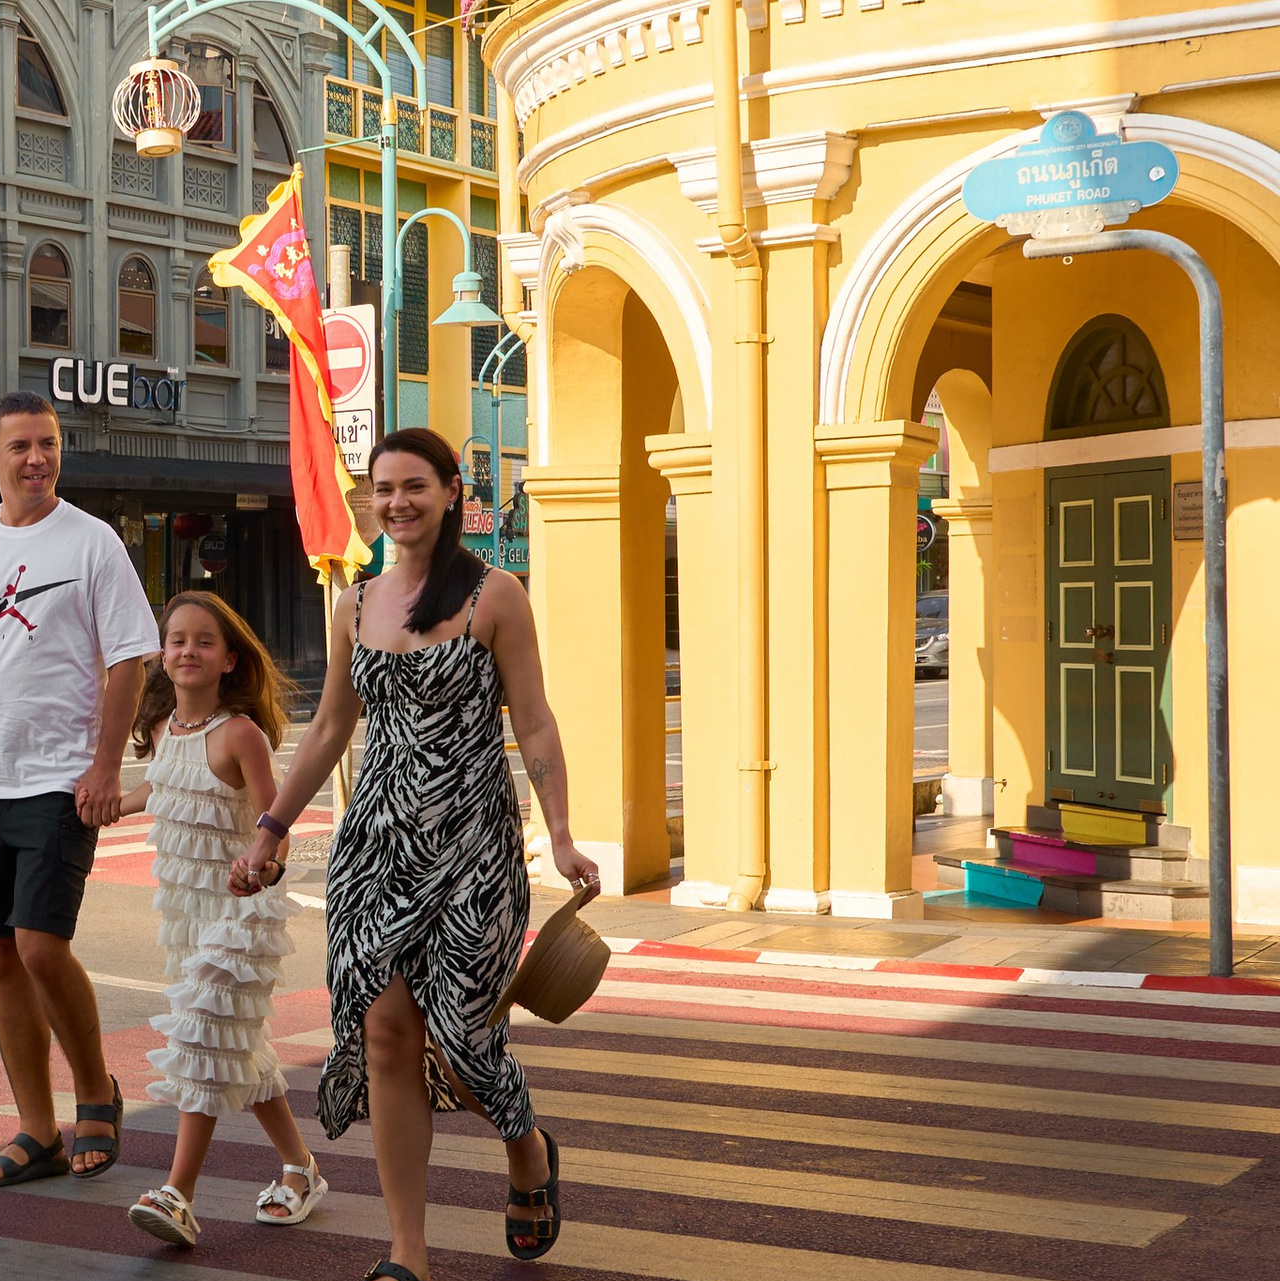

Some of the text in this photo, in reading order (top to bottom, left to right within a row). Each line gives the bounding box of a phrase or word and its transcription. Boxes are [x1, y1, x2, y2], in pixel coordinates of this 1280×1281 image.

[1087, 140, 1118, 149] MUNICIPALITY
[1017, 149, 1118, 189] ถนนภูเก็ต
[1026, 187, 1111, 206] PHUKET ROAD
[338, 452, 362, 465] TRY
[462, 511, 494, 534] TLENG
